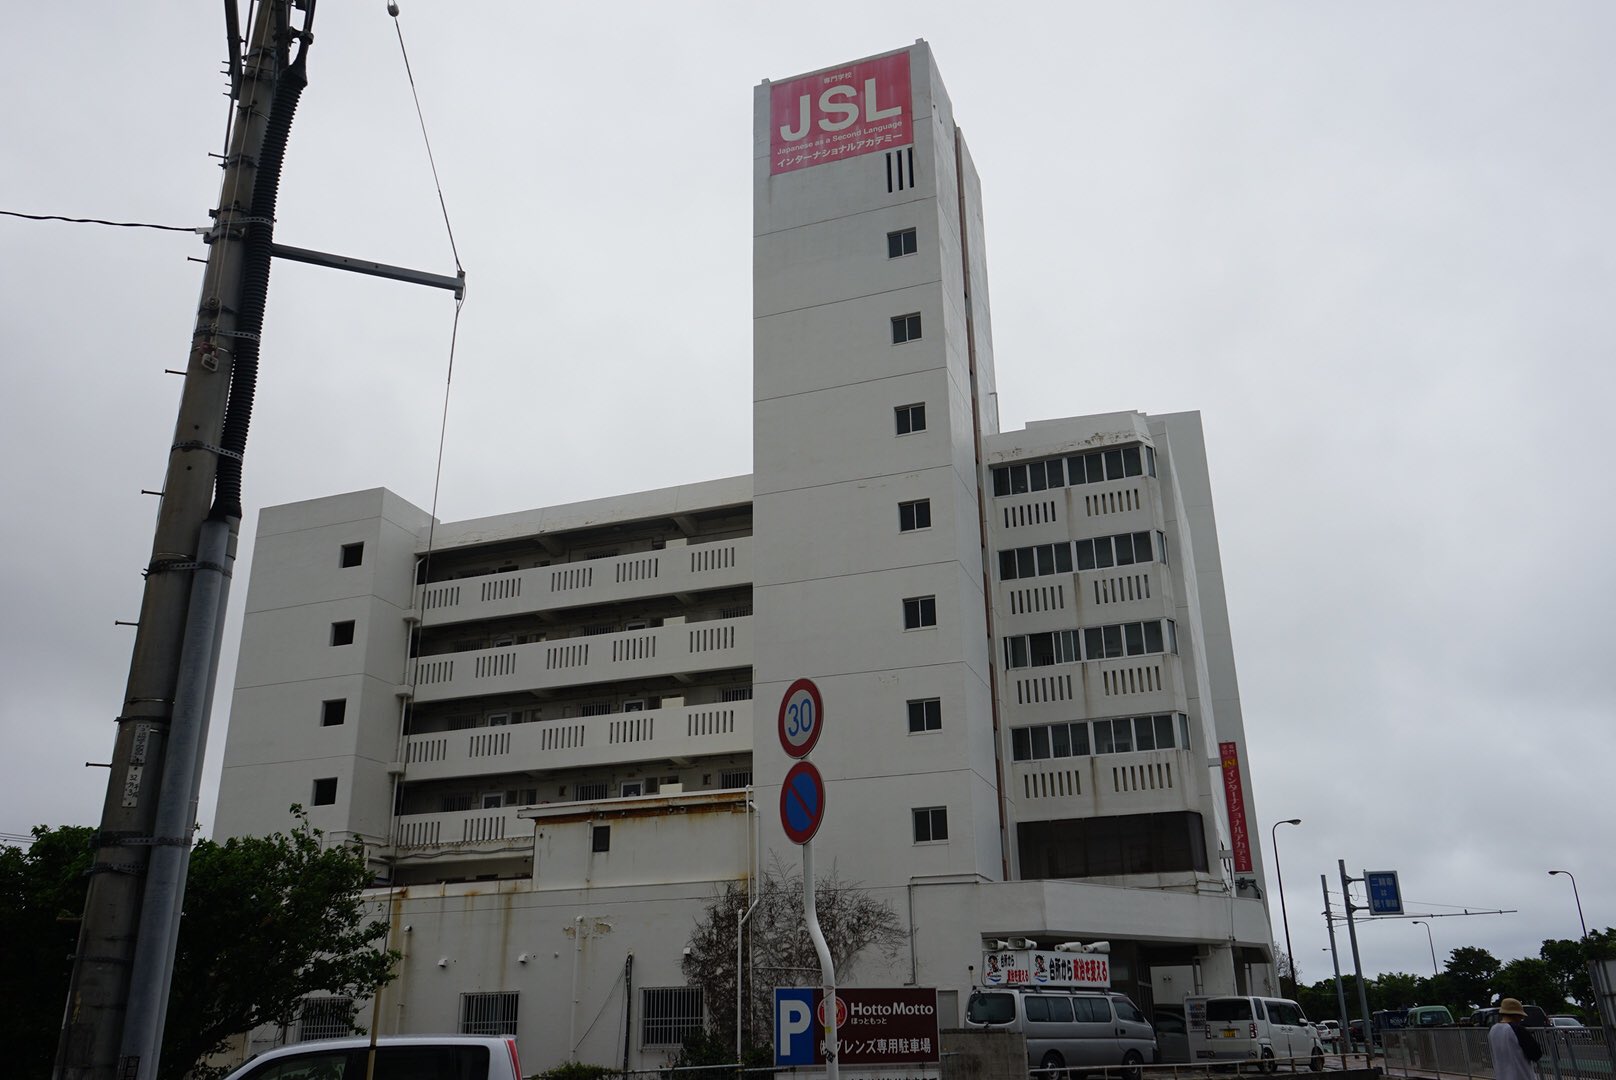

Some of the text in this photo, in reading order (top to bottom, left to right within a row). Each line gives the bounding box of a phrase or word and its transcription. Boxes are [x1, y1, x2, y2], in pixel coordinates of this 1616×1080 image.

[823, 71, 852, 84] 専門学校
[780, 78, 902, 142] JSL
[777, 142, 813, 155] Japanese
[832, 130, 862, 142] Second
[863, 121, 903, 135] Language
[777, 134, 902, 168] インターナショナルアカデミー
[788, 698, 812, 737] 30
[780, 1000, 811, 1056] P
[851, 1017, 888, 1025] ほっともっと
